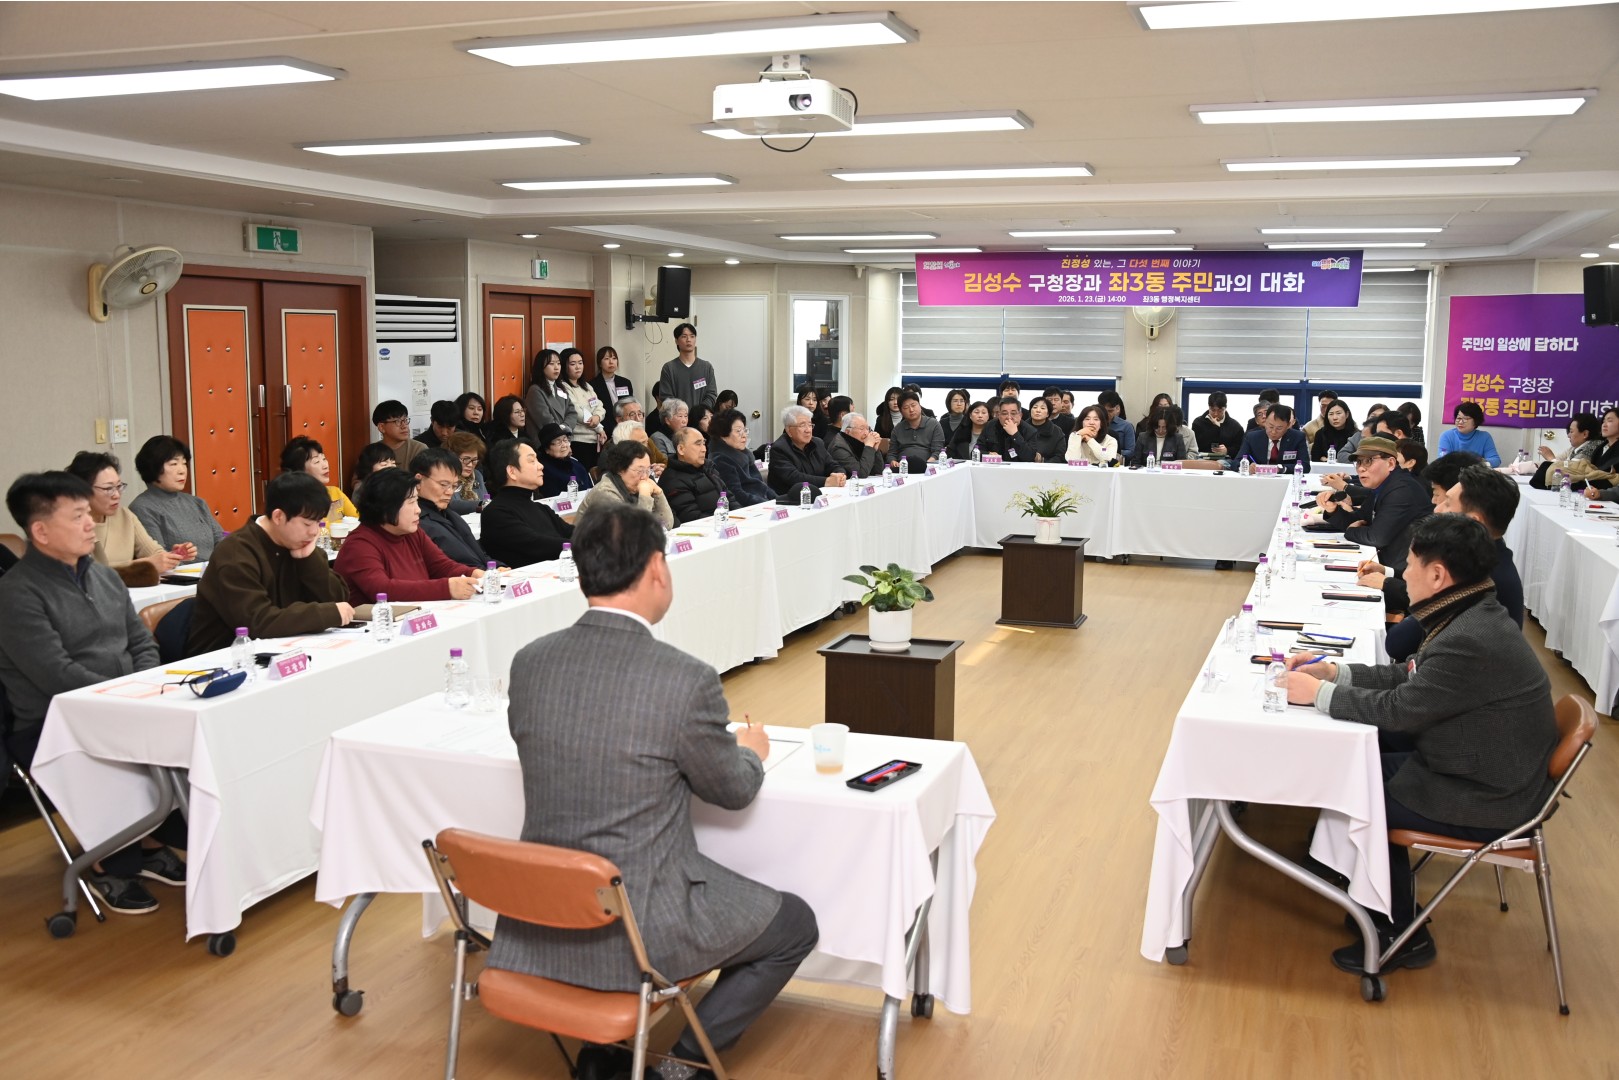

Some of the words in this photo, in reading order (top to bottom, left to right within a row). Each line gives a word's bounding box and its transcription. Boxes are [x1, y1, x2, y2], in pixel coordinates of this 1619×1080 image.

[1061, 258, 1091, 269] 진정성
[1093, 259, 1115, 269] 있는,
[1116, 259, 1126, 268] 그
[1129, 259, 1148, 268] 다섯
[1151, 259, 1170, 268] 번째
[1173, 259, 1201, 268] 이야기
[964, 272, 1022, 293] 김성수
[1028, 273, 1102, 293] 구청장과
[1108, 272, 1166, 293] 좌3동
[1171, 272, 1252, 293] 주민과의
[1260, 272, 1305, 293] 대화
[1058, 295, 1077, 303] 2026.
[1142, 295, 1160, 303] 좌3동
[1161, 295, 1201, 303] 행정복지센터
[1461, 337, 1495, 352] 주민의
[1497, 337, 1531, 352] 일상에
[1534, 337, 1579, 352] 답하다
[1462, 373, 1505, 393] 김성수
[1508, 377, 1554, 394] 구청장
[1460, 397, 1500, 417] 3동
[1503, 398, 1574, 419] 주민과의
